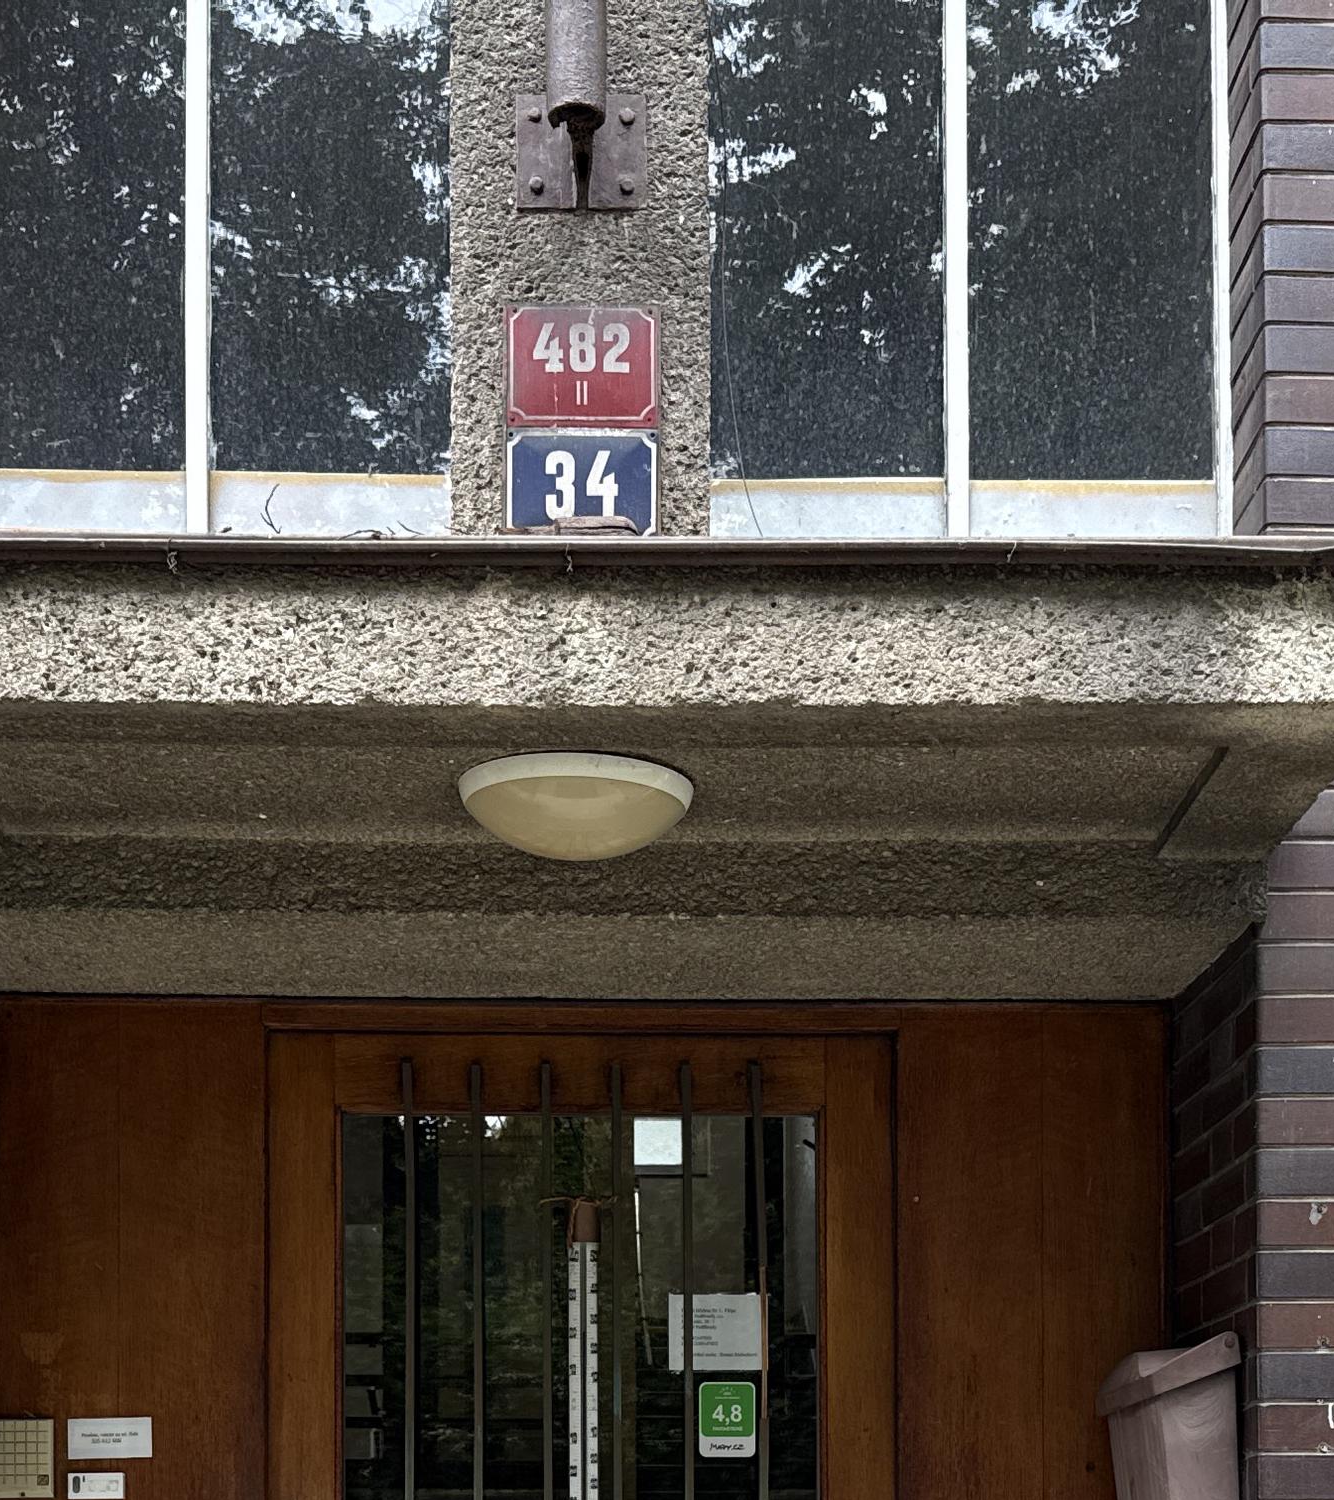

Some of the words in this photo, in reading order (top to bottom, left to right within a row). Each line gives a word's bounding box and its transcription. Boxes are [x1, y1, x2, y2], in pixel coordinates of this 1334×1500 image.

[532, 322, 631, 374] 482
[544, 450, 619, 521] 34
[712, 1403, 742, 1425] 4,8
